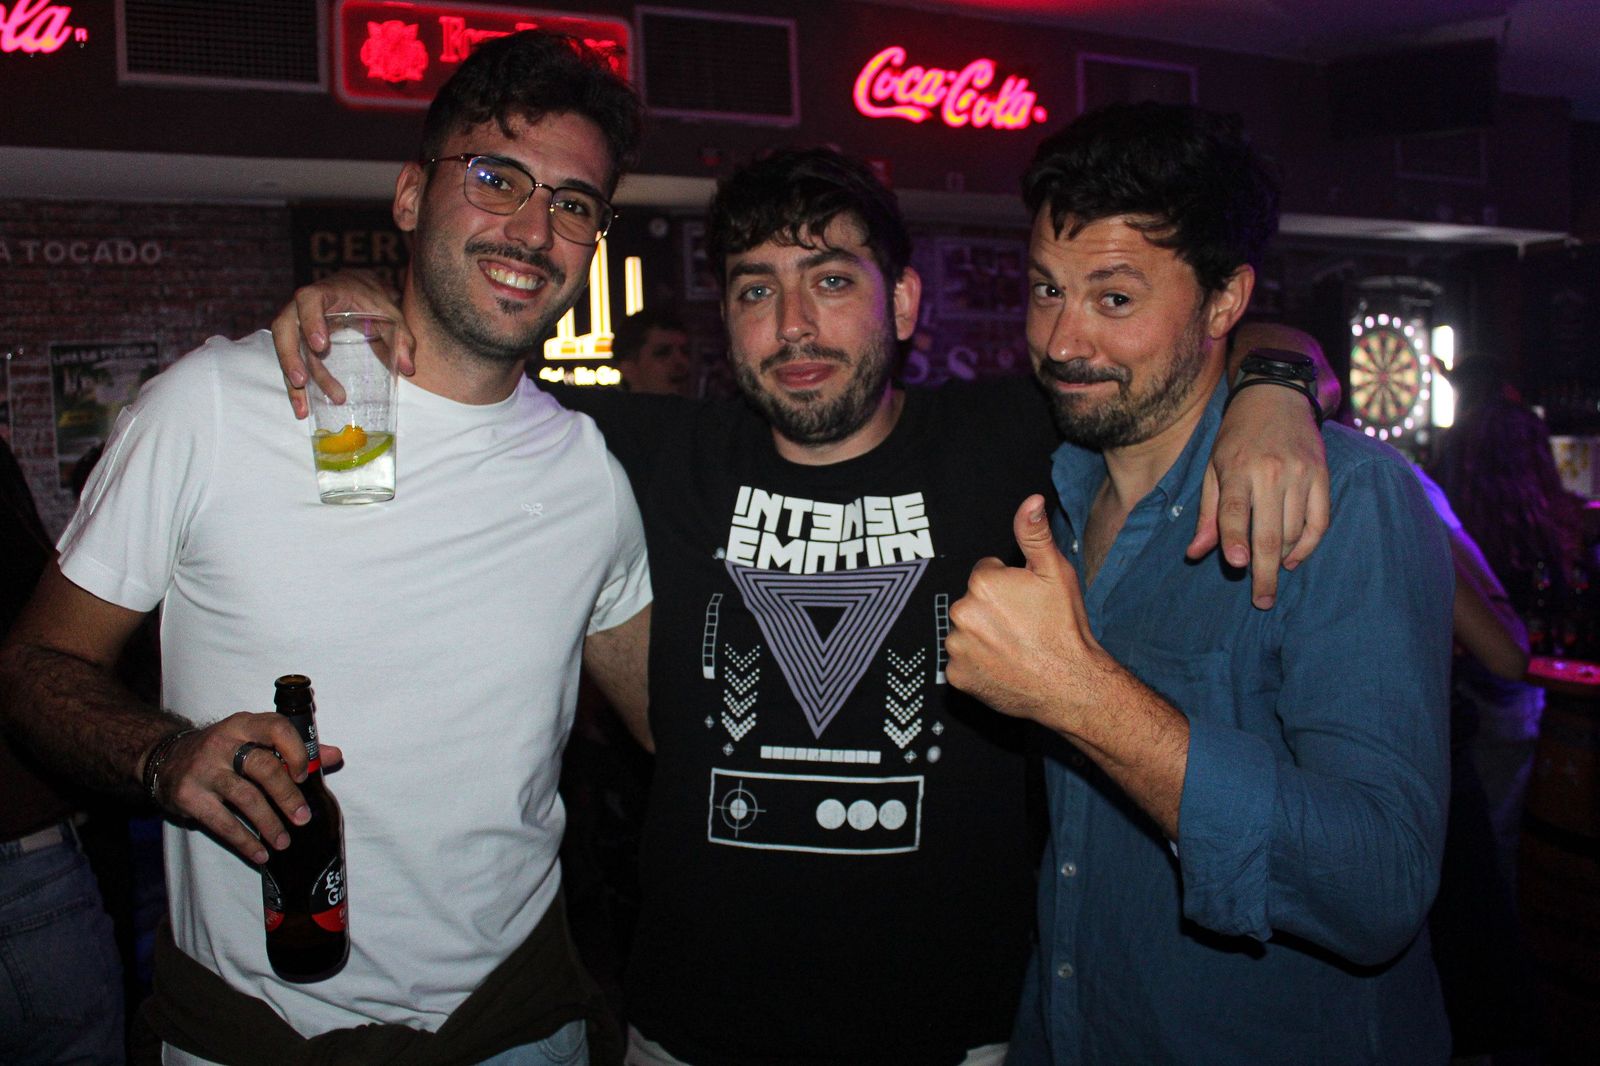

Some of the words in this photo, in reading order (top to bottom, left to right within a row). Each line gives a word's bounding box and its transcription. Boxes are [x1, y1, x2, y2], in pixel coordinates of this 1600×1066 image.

[853, 46, 1037, 129] Coca-Cola
[19, 240, 163, 265] TOCADO
[731, 485, 930, 542] INTENSE
[725, 525, 935, 575] EMOTION
